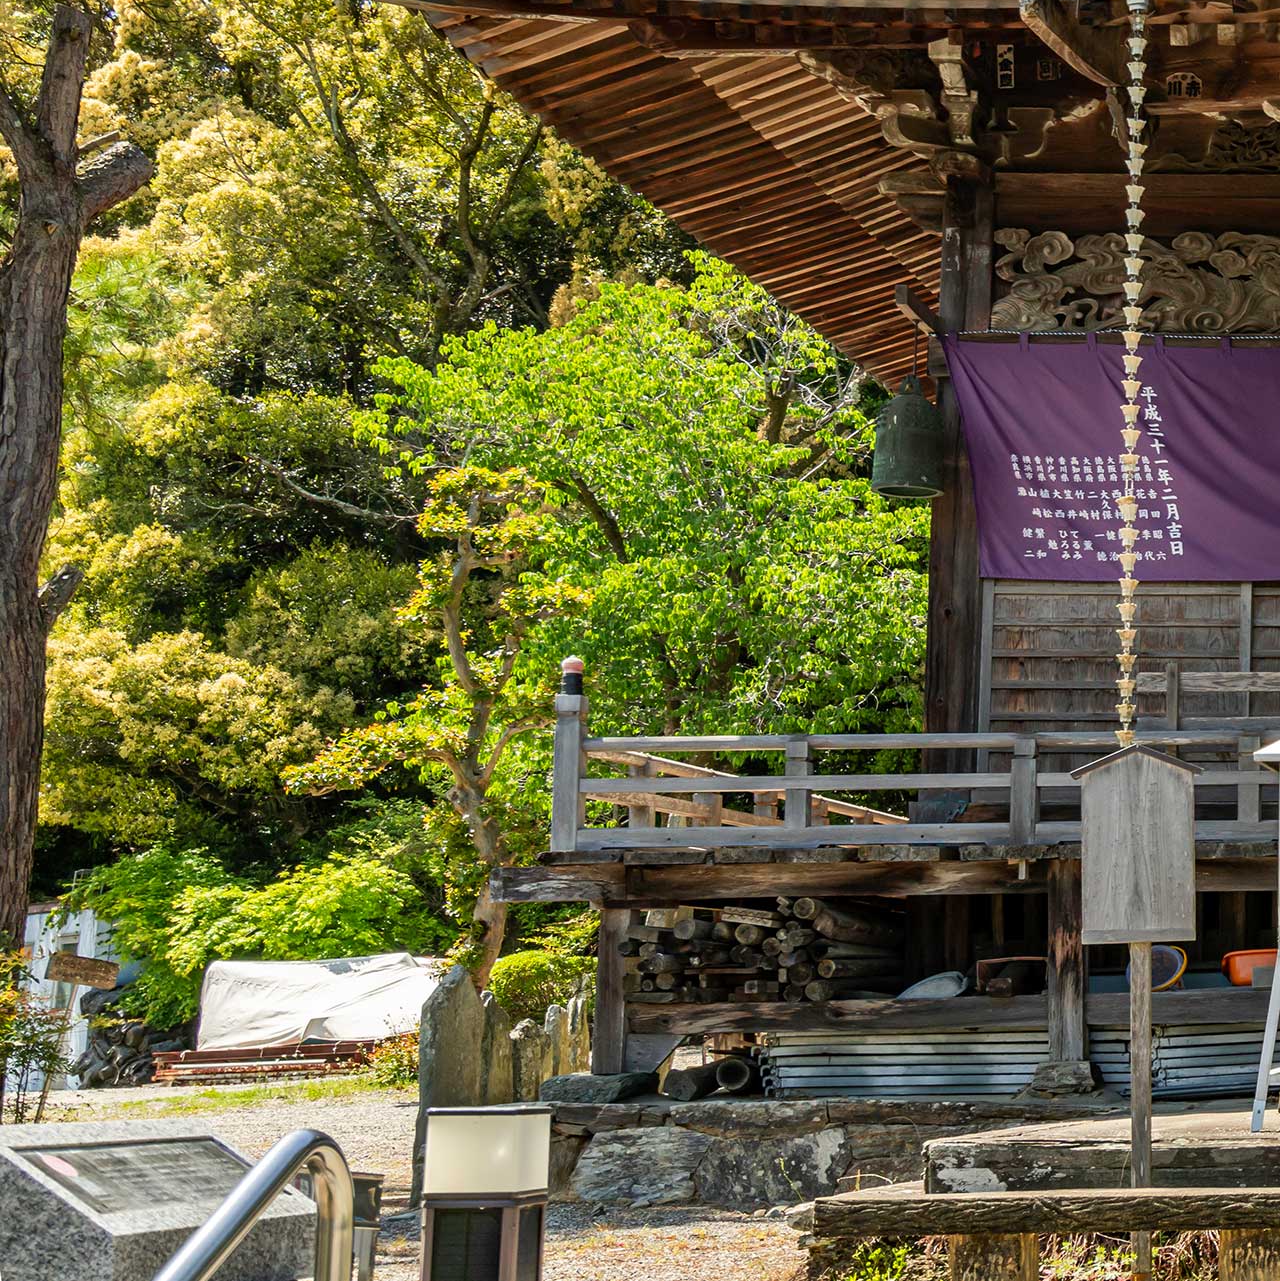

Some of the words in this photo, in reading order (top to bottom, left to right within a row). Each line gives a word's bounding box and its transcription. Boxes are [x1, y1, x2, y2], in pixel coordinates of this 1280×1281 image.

[1141, 387, 1183, 556] 平成三十一年二月吉日
